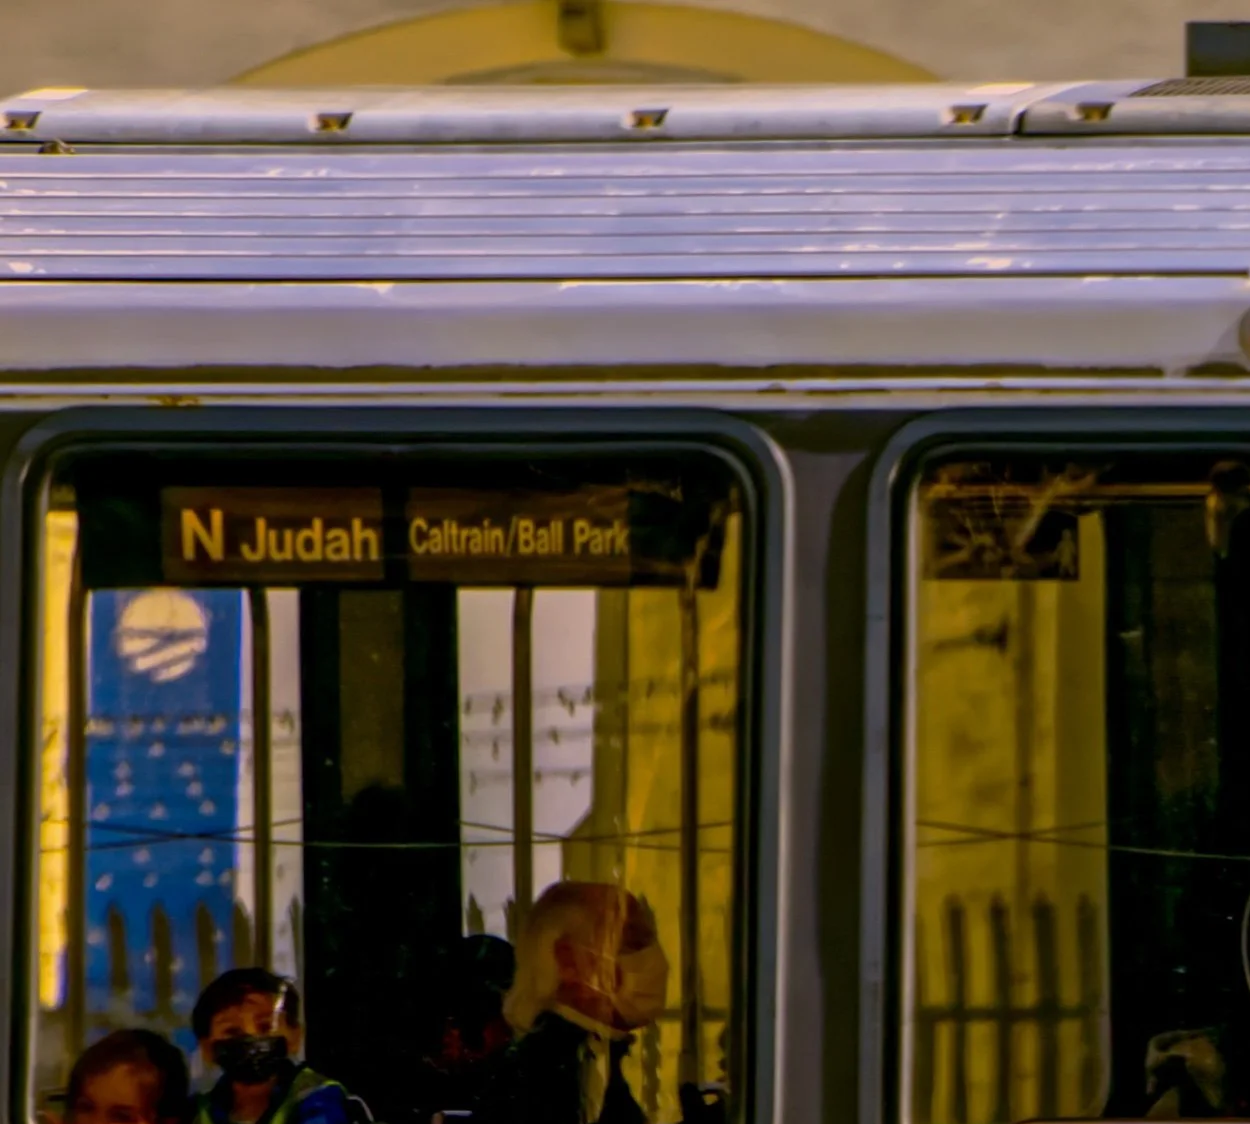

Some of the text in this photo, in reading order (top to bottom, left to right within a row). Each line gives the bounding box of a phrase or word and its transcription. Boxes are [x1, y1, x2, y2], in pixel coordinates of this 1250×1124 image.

[180, 509, 379, 561] N Judah
[409, 517, 628, 556] Caltrain/Ball Park
